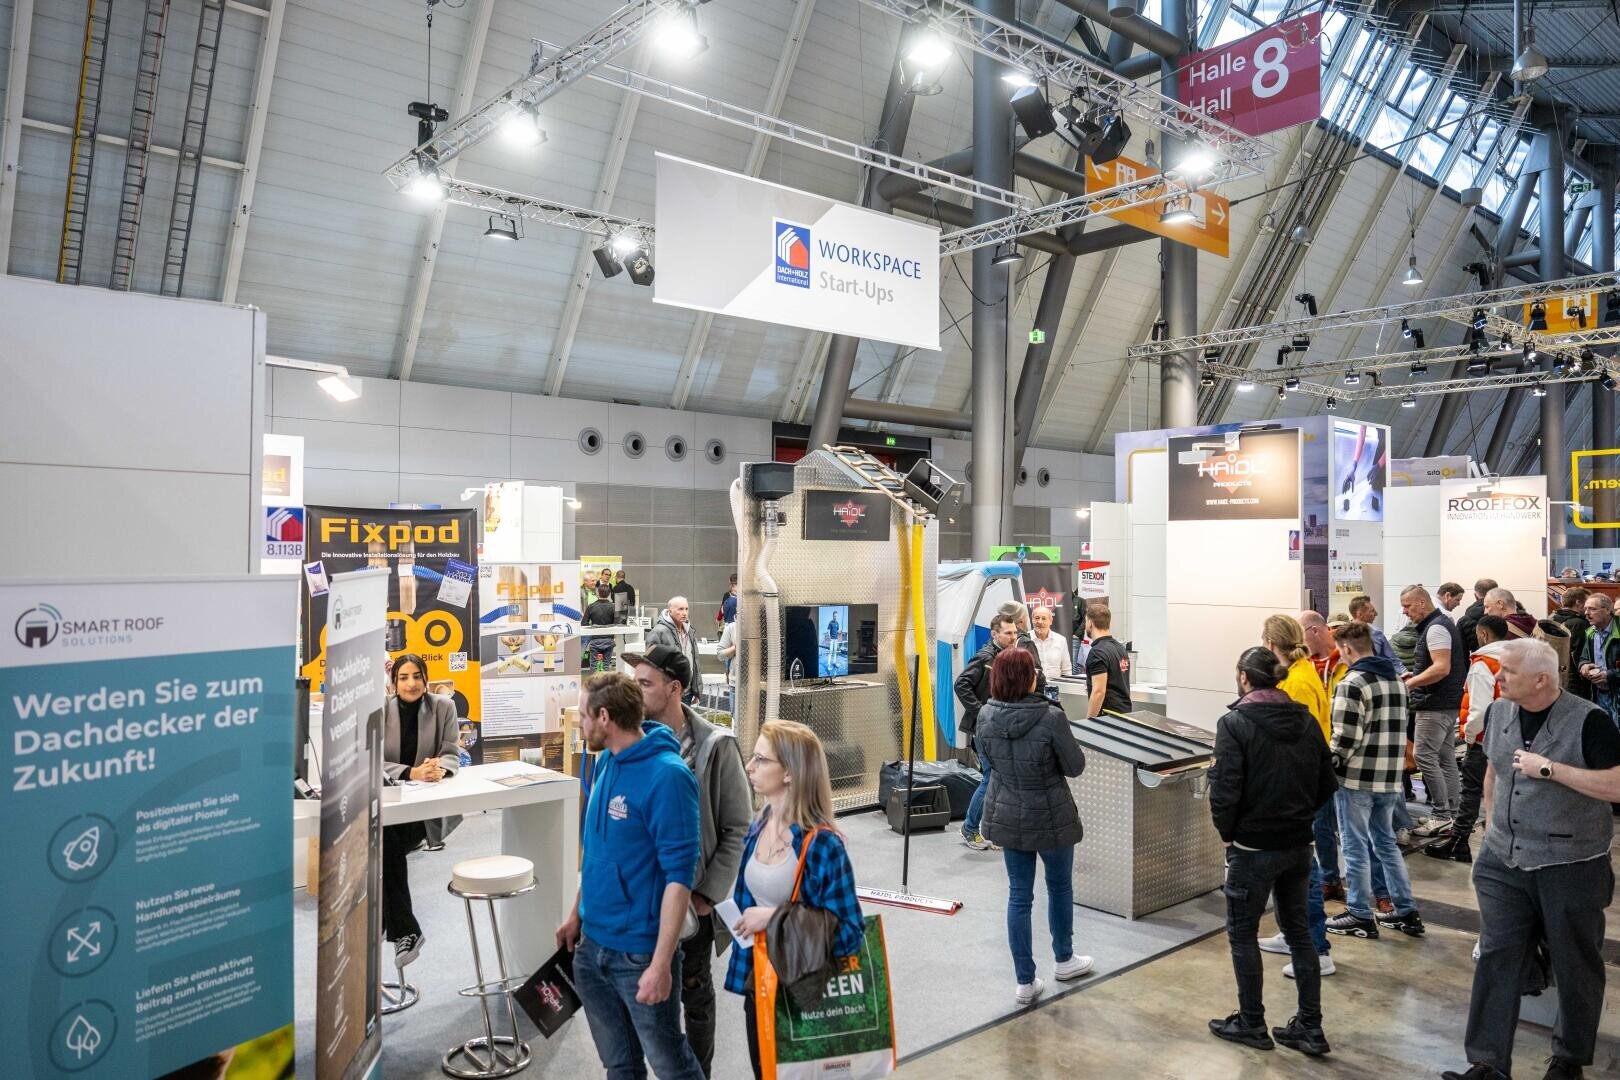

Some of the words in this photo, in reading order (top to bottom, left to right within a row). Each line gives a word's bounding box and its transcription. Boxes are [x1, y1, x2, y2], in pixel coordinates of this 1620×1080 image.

[1189, 52, 1246, 87] Halle
[1252, 37, 1289, 98] 8
[1189, 87, 1231, 119] Hall
[777, 265, 808, 279] DACH+HOLZ
[819, 239, 922, 279] WORKSPACE
[820, 271, 894, 305] Start-Ups
[1448, 497, 1542, 512] ROOFFOX
[320, 518, 460, 550] Fixpod
[363, 551, 416, 560] Installationslösung
[496, 581, 564, 597] Fixpod
[62, 619, 120, 635] SMART
[124, 617, 164, 631] ROOF
[62, 635, 133, 648] SOLUTIONS
[331, 654, 371, 687] Nachhaltige
[421, 653, 443, 661] Blick
[13, 686, 146, 719] Werden
[155, 678, 198, 704] Sie
[206, 677, 263, 699] zum
[14, 712, 206, 755] Dachdecker
[214, 705, 259, 728] der
[13, 748, 155, 791] Zukunft!
[136, 800, 201, 821] Positionieren
[202, 797, 218, 808] Sie
[219, 793, 239, 804] sich
[136, 823, 151, 834] als
[152, 814, 193, 831] digitaler
[195, 808, 229, 821] Pionier
[136, 893, 172, 911] Nutzen
[174, 888, 189, 899] Sie
[191, 883, 215, 895] neue
[136, 888, 241, 923] Handlungsspielräume
[136, 982, 172, 1000] Liefern
[173, 975, 189, 987] Sie
[190, 966, 217, 981] einen
[218, 955, 253, 972] aktiven
[136, 993, 173, 1013] Beitrag
[174, 987, 196, 1000] zum
[197, 966, 255, 992] Klimaschutz
[823, 973, 864, 998] EEN
[801, 1010, 825, 1021] Nutze
[826, 1006, 844, 1017] dein
[844, 1003, 866, 1015] Dach!
